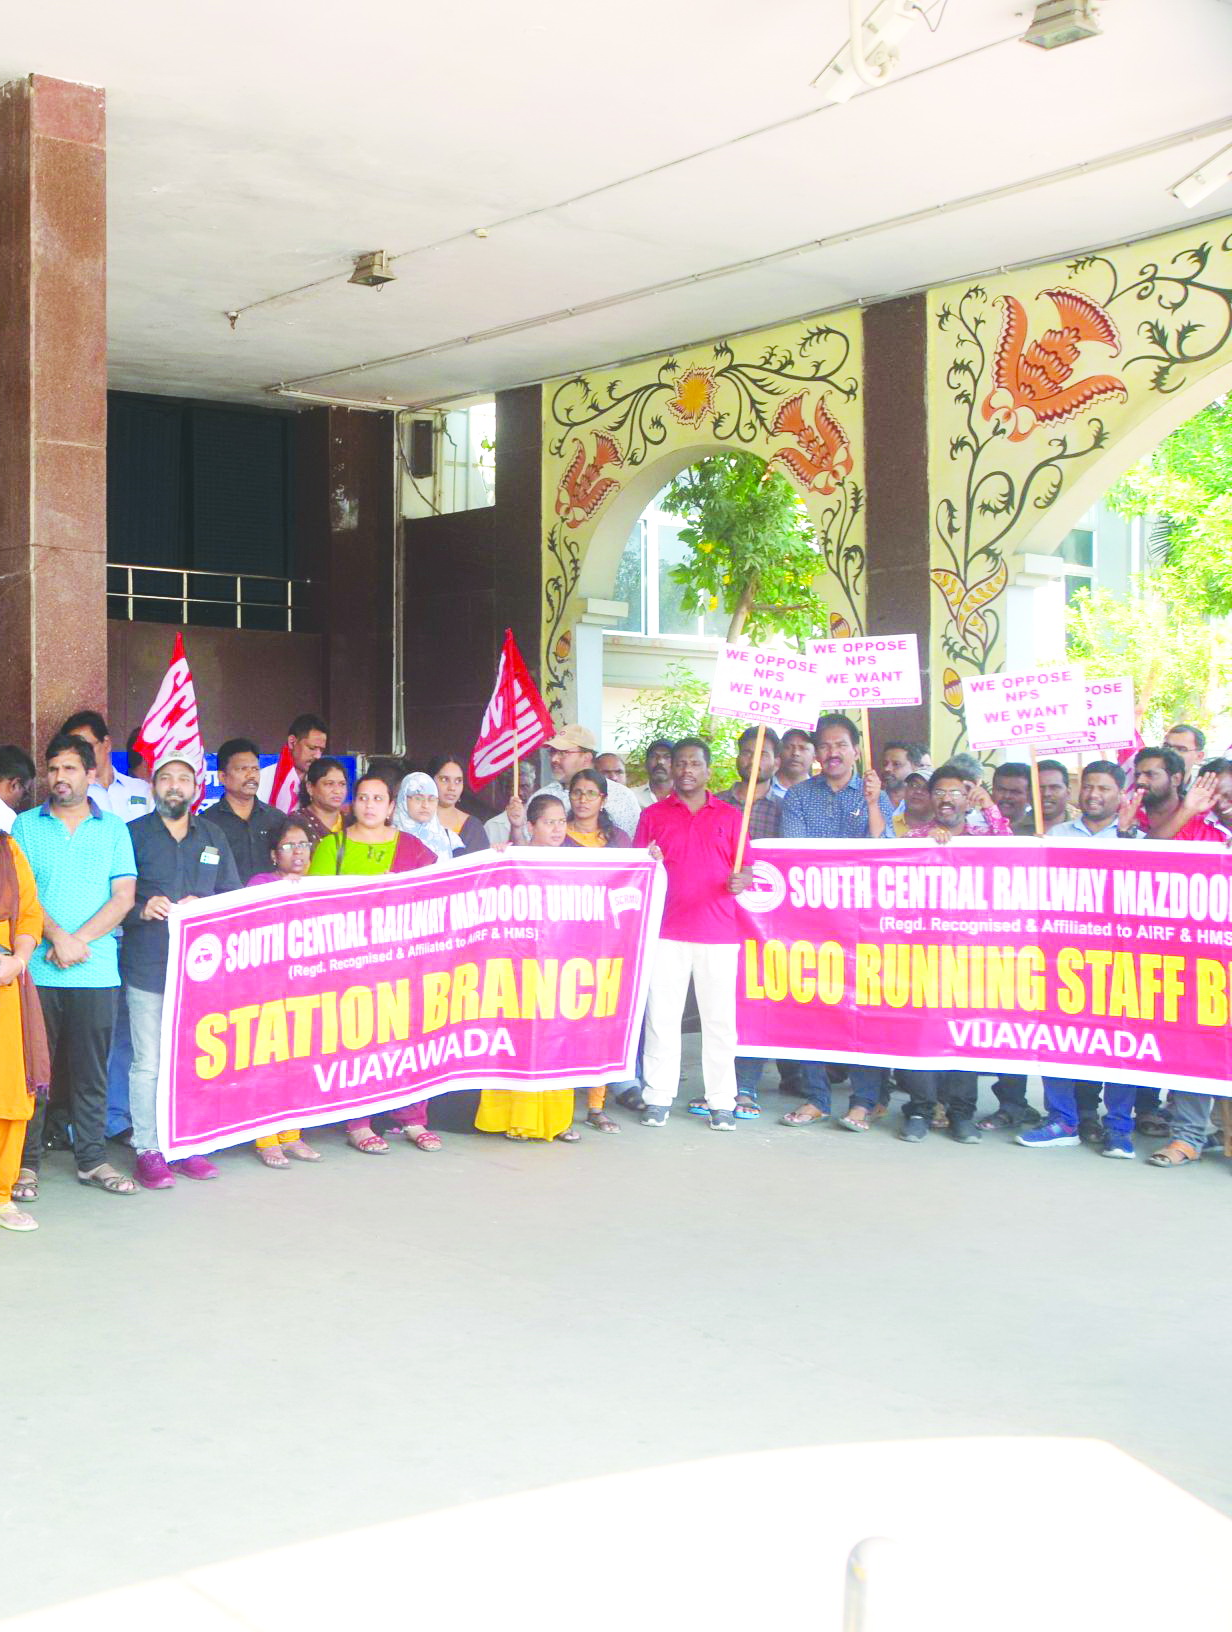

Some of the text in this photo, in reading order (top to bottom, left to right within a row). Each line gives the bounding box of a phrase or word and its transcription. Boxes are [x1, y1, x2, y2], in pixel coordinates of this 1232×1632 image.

[813, 640, 907, 654] WE OPPOSE
[726, 649, 818, 673] WE OPPOSE
[845, 656, 877, 665] NPS
[753, 668, 785, 682] NPS
[825, 671, 903, 684] WE WANT
[970, 671, 1072, 692] WE OPPOSE
[730, 682, 806, 704] WE WANT
[849, 687, 881, 697] OPS
[1005, 689, 1040, 702] NPS
[749, 701, 780, 715] OPS
[984, 704, 1069, 723] WE WANT
[1011, 722, 1046, 736] OPS
[1088, 714, 1118, 727] ANT
[788, 865, 1232, 922] SOUTH CENTRAL RAILWAY MAZDOO
[226, 884, 606, 972] SOUTH CENTRAL RAILWAY MAZDOOR UNION
[879, 916, 926, 934] (Regd.
[931, 917, 1021, 935] Recognised
[1026, 918, 1037, 933] &
[1042, 918, 1112, 937] Affiliated
[1117, 923, 1132, 938] to
[1136, 925, 1175, 941] AIRF
[1179, 928, 1192, 943] &
[288, 927, 539, 980] (Regd. Recognised & Affiliated to AIRF & HMS)
[745, 939, 1232, 1027] LOCO RUNNING STAFF B
[195, 957, 625, 1079] STATION BRANCH
[948, 1020, 1162, 1062] VIJAYAWADA
[313, 1027, 517, 1093] VIJAYAWADA
